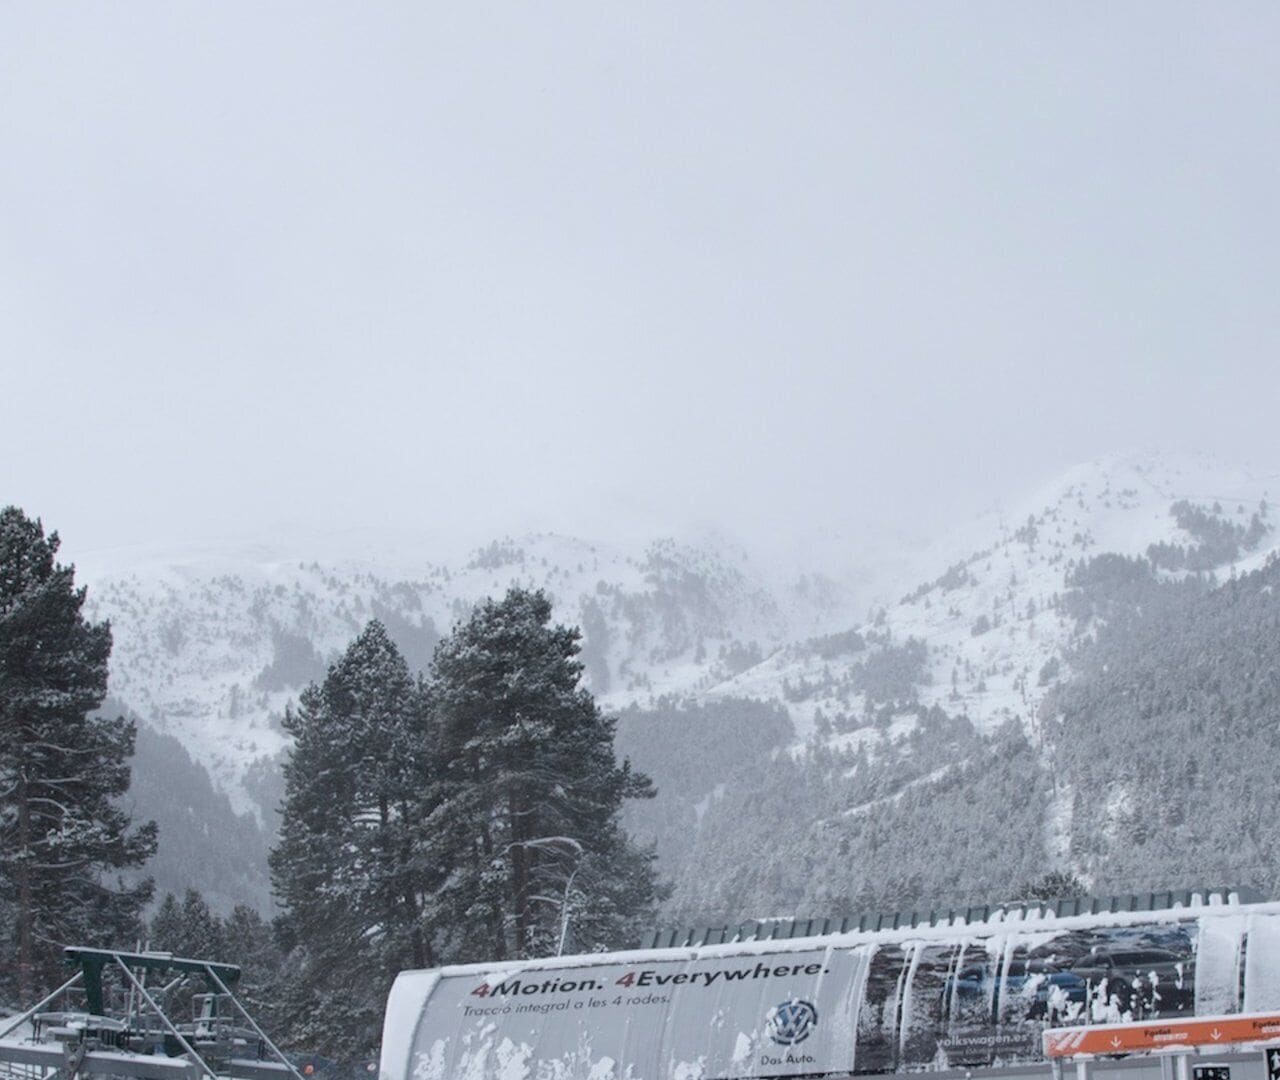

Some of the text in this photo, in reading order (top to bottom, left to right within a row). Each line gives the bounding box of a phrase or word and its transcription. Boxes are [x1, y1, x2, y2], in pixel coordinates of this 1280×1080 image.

[471, 962, 831, 999] 4Motion. 4Everywhere.
[515, 998, 570, 1015] integral
[573, 1001, 584, 1010] a
[588, 996, 608, 1009] les
[612, 995, 623, 1007] 4
[761, 1053, 816, 1067] Das Auto.
